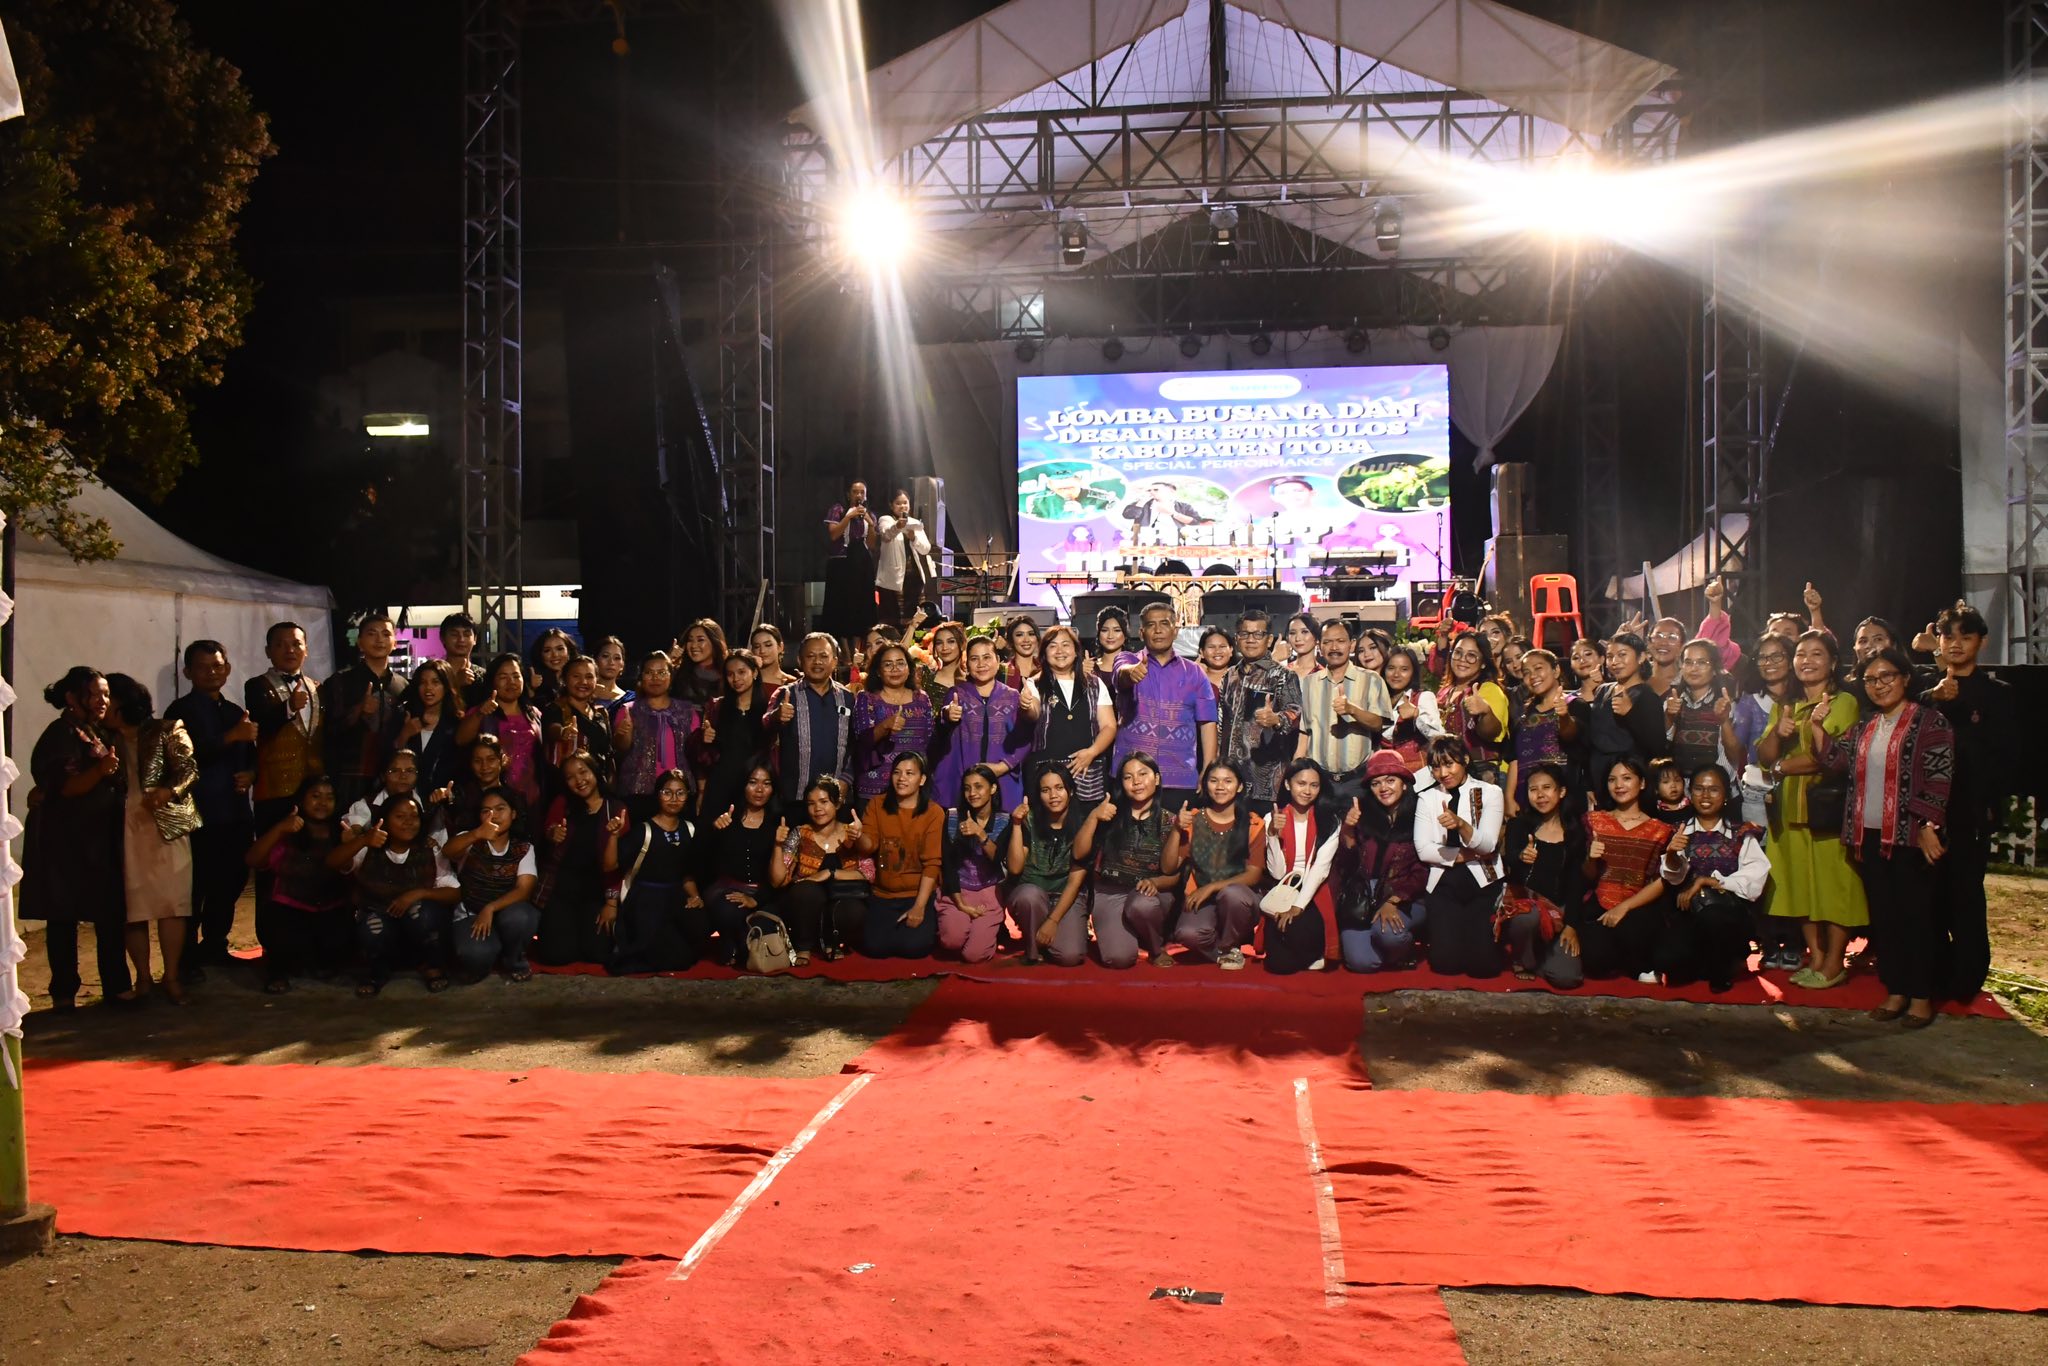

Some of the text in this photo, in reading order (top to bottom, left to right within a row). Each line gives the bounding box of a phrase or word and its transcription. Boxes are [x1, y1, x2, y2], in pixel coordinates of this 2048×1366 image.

[1049, 400, 1419, 427] LOMBA BUSANA DAN
[1058, 421, 1409, 444] DESAINER ETNIK ULOS
[1091, 439, 1377, 460] KABUPATEN TOBA
[1122, 457, 1335, 471] SPECIAL PERFORMANCE
